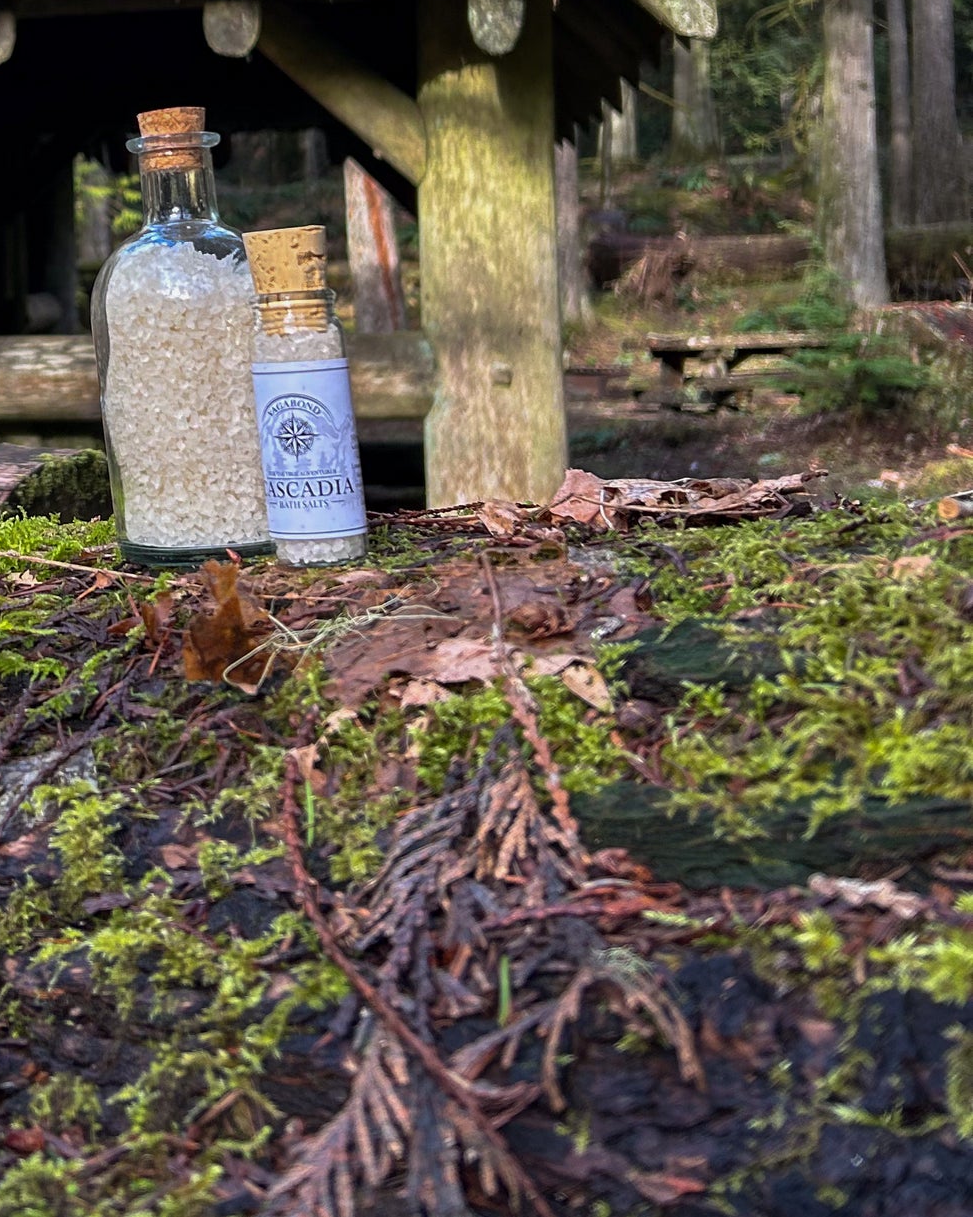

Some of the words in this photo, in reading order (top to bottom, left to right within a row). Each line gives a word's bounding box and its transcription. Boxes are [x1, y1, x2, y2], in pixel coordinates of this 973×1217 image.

[267, 399, 322, 416] VAGABOND
[279, 501, 301, 509] BATH
[302, 498, 329, 509] SALTS
